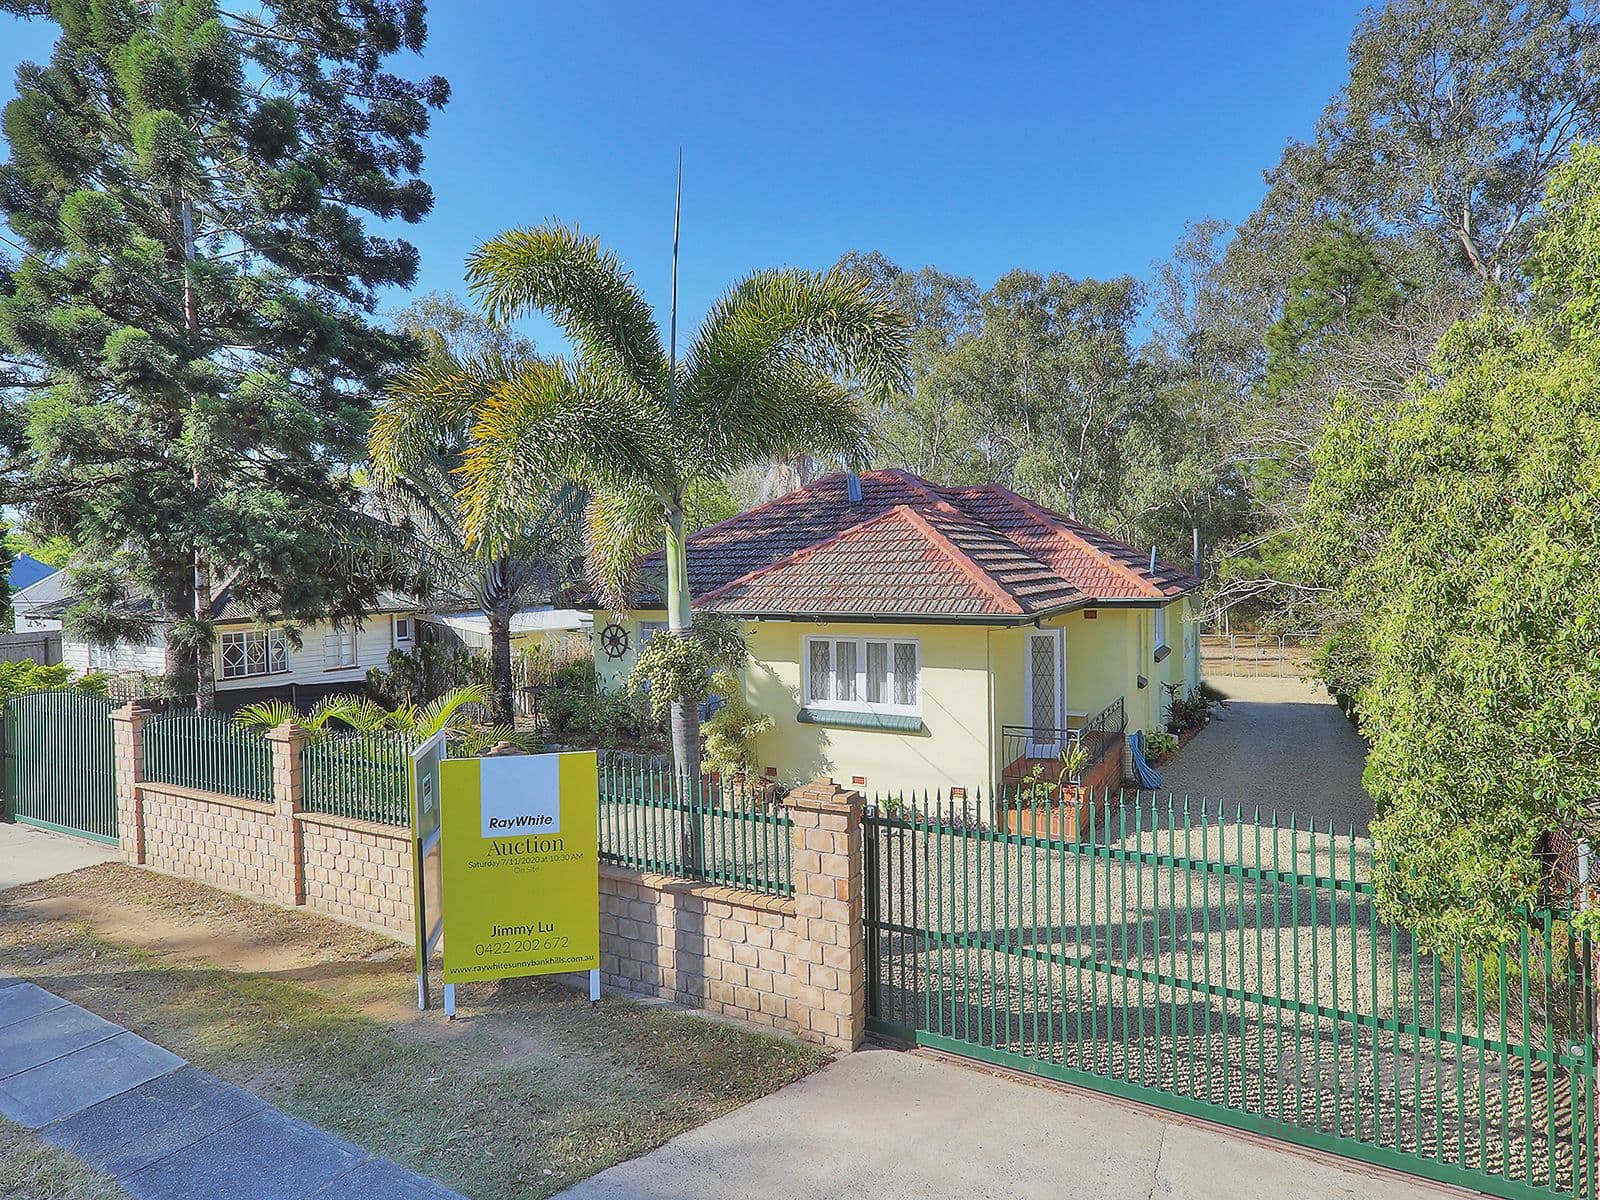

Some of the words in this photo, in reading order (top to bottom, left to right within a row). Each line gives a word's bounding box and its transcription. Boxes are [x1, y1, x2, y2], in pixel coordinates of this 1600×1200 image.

[487, 836, 564, 857] Auction
[468, 859, 500, 869] Saturday
[570, 853, 584, 861] AM
[490, 924, 534, 938] Jimmy
[538, 922, 554, 933] Lu
[475, 942, 510, 957] 0422
[514, 939, 540, 953] 202
[543, 936, 569, 949] 672
[449, 955, 595, 975] www.raywhitesunnybankhills.com.au
